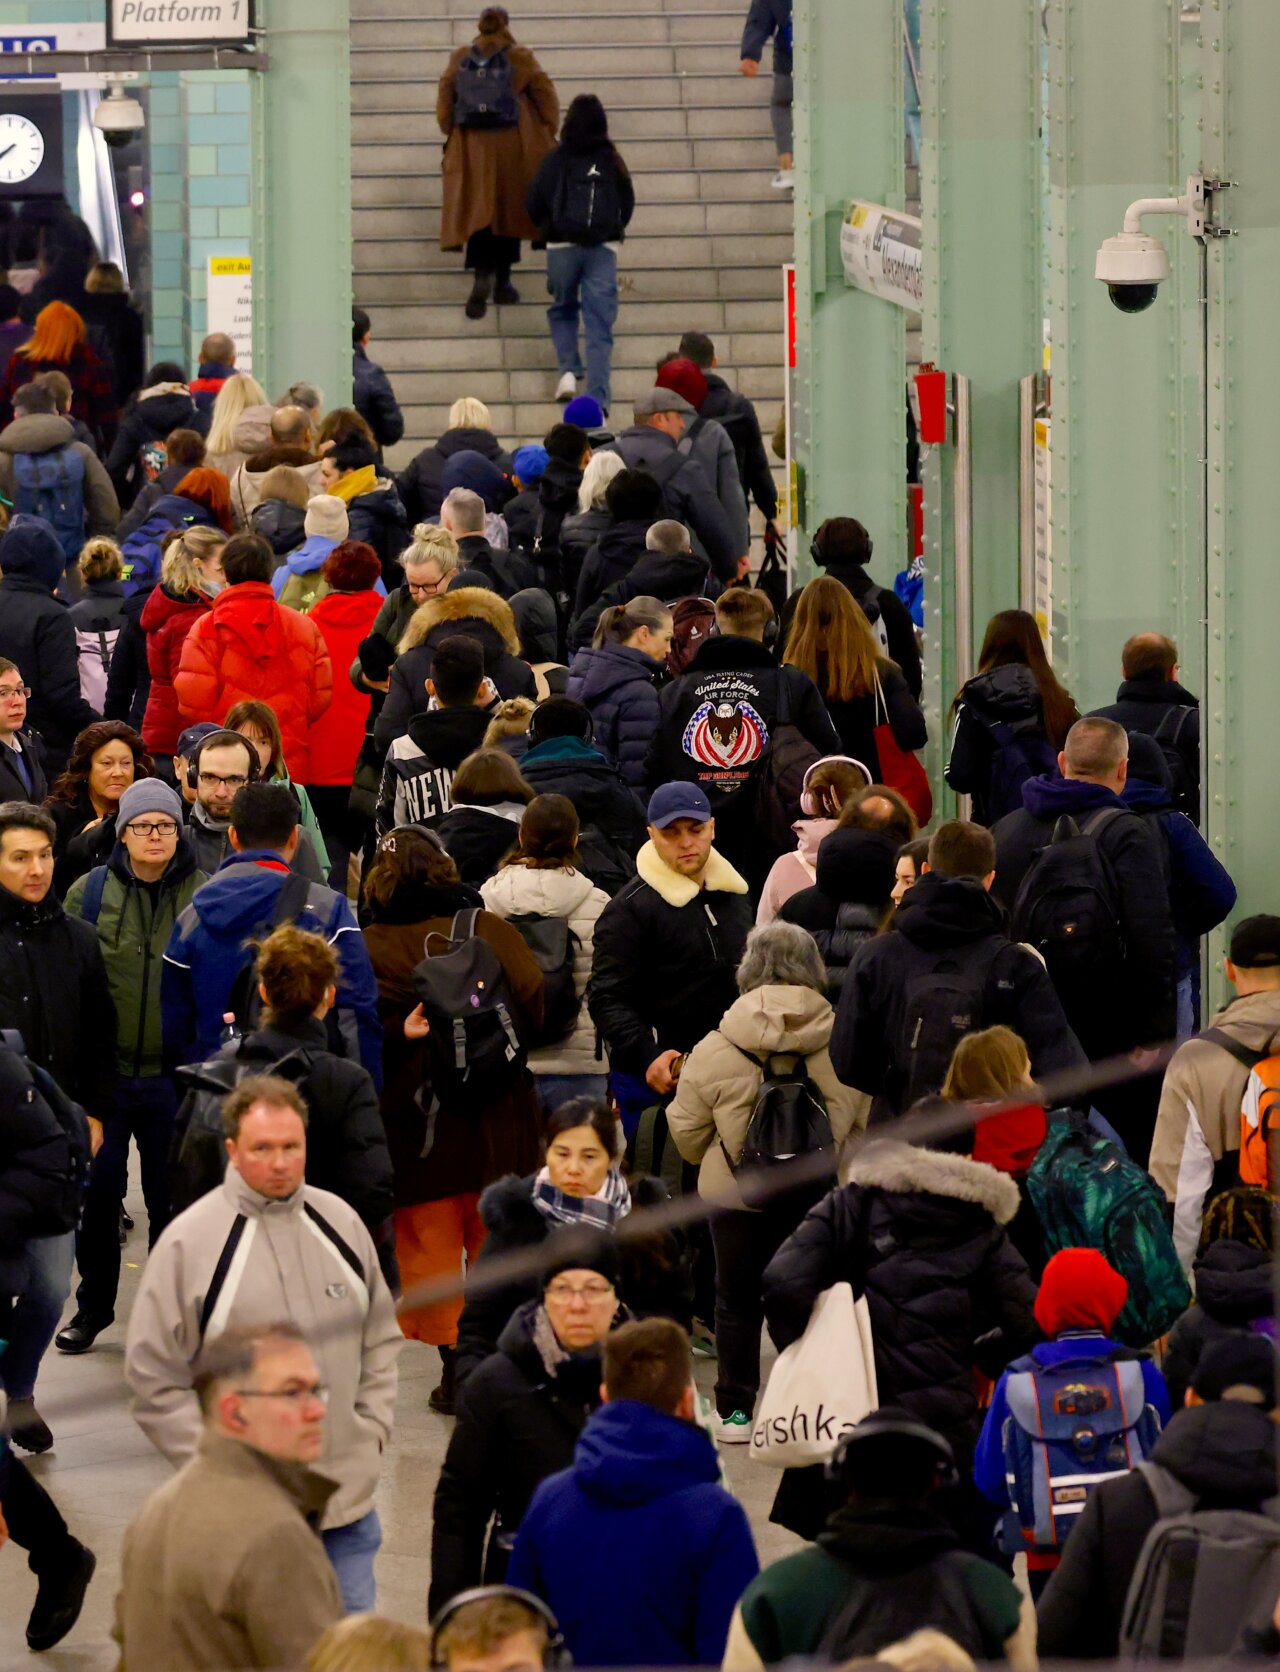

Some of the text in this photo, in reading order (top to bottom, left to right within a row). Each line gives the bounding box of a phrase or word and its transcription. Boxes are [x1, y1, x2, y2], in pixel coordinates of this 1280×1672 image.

[121, 0, 240, 24] Platform 1
[694, 679, 760, 697] United States
[704, 691, 719, 701] AIR
[720, 691, 750, 700] FORCE
[403, 767, 457, 823] NEW
